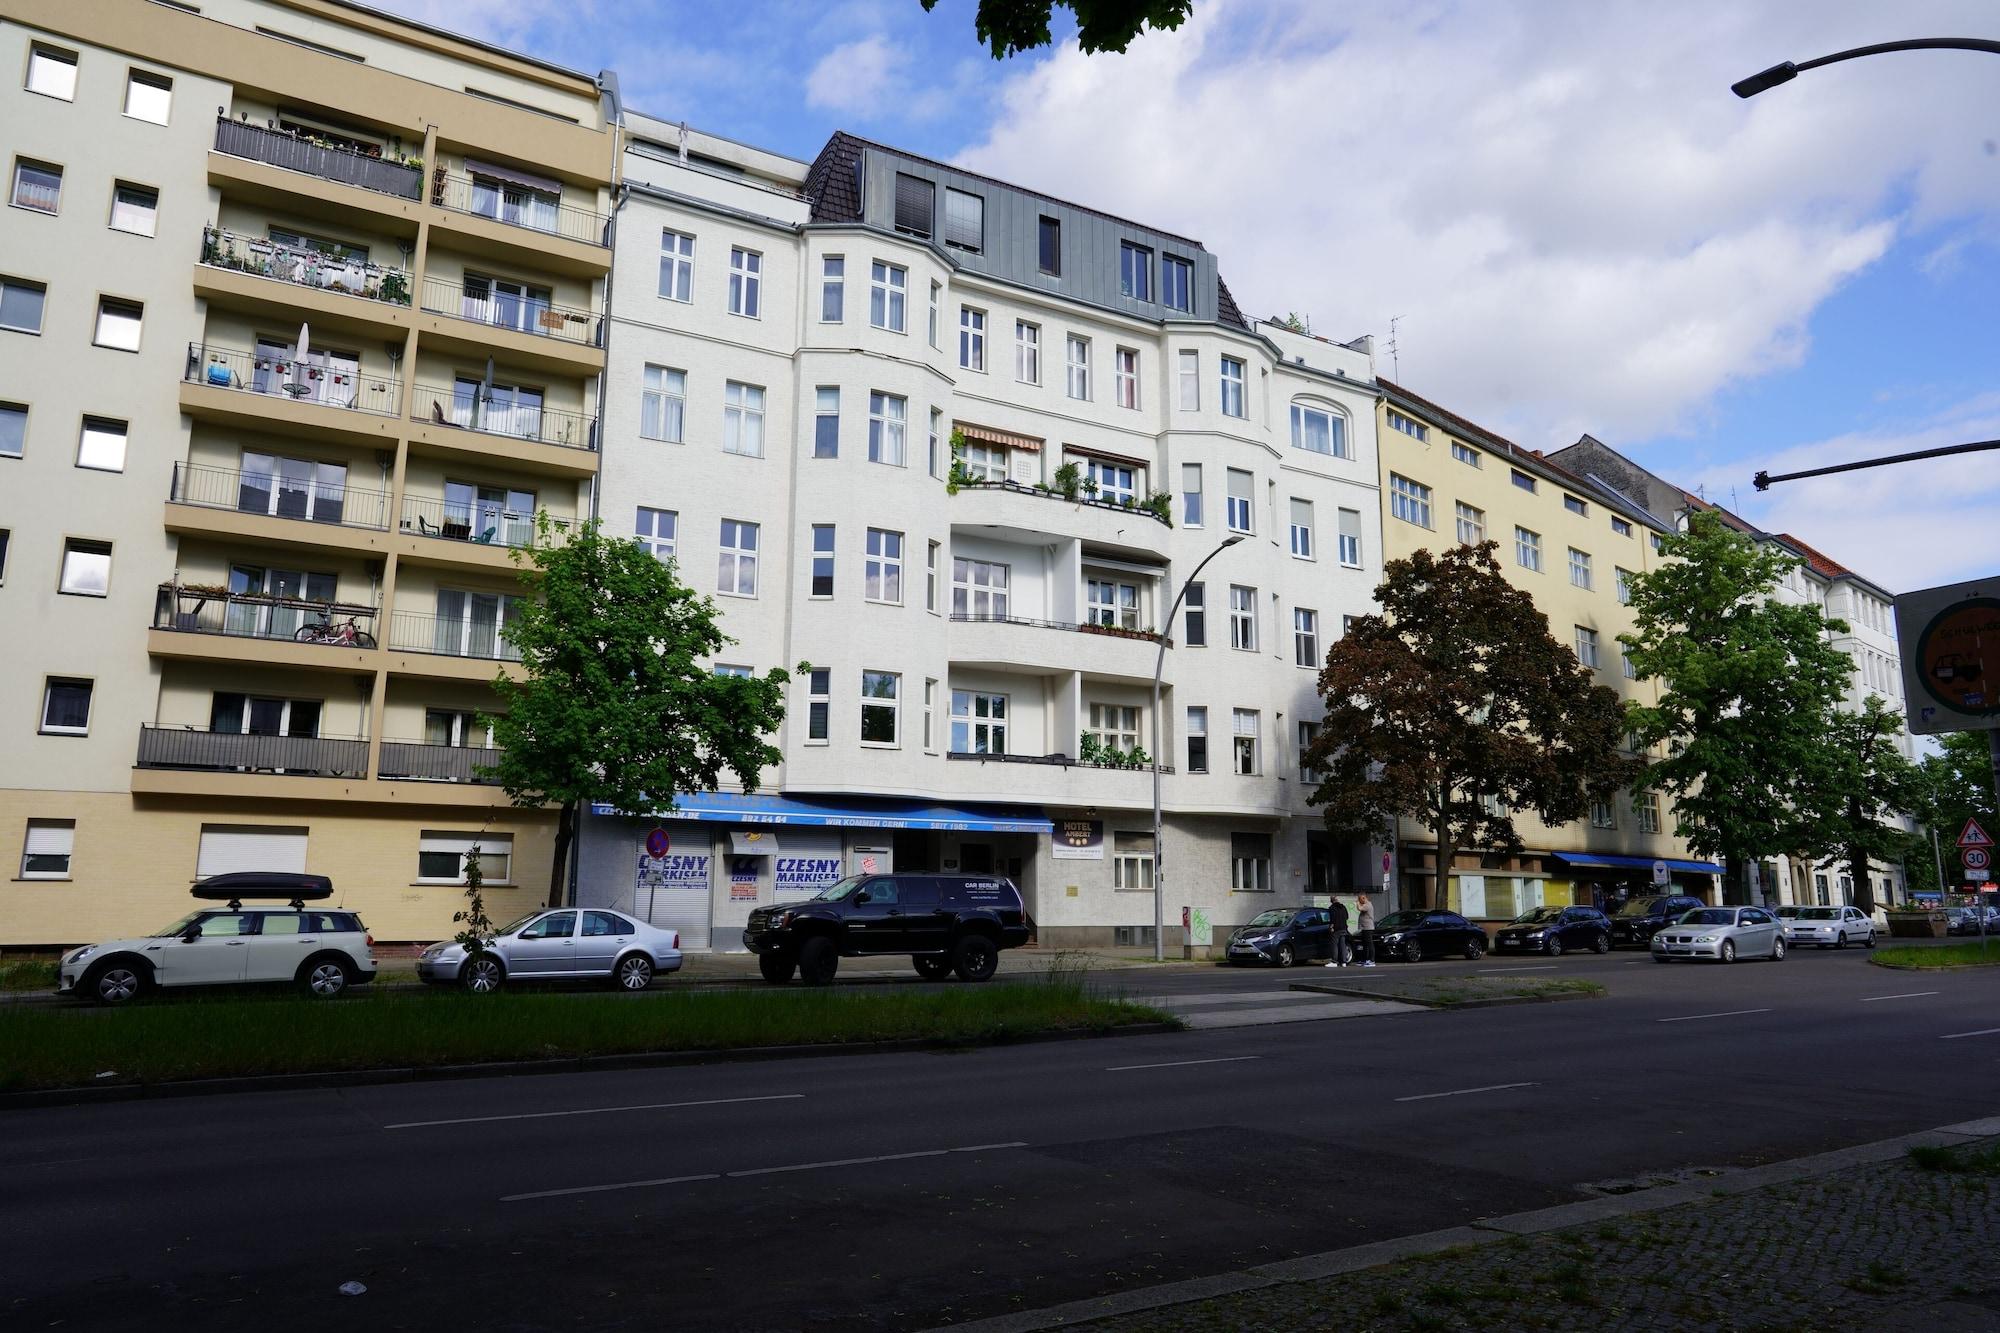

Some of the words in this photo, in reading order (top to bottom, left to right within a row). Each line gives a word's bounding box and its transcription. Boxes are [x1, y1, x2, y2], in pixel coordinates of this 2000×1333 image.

[825, 817, 841, 826] WIR
[843, 818, 880, 828] KOMMEN
[930, 822, 948, 830] SEIT
[1064, 822, 1092, 831] HOTEL
[638, 855, 709, 871] CESNY
[1968, 853, 1984, 864] 30
[776, 859, 840, 873] CZESNY
[638, 870, 708, 881] MRKISEN
[776, 873, 840, 883] MARKISEN
